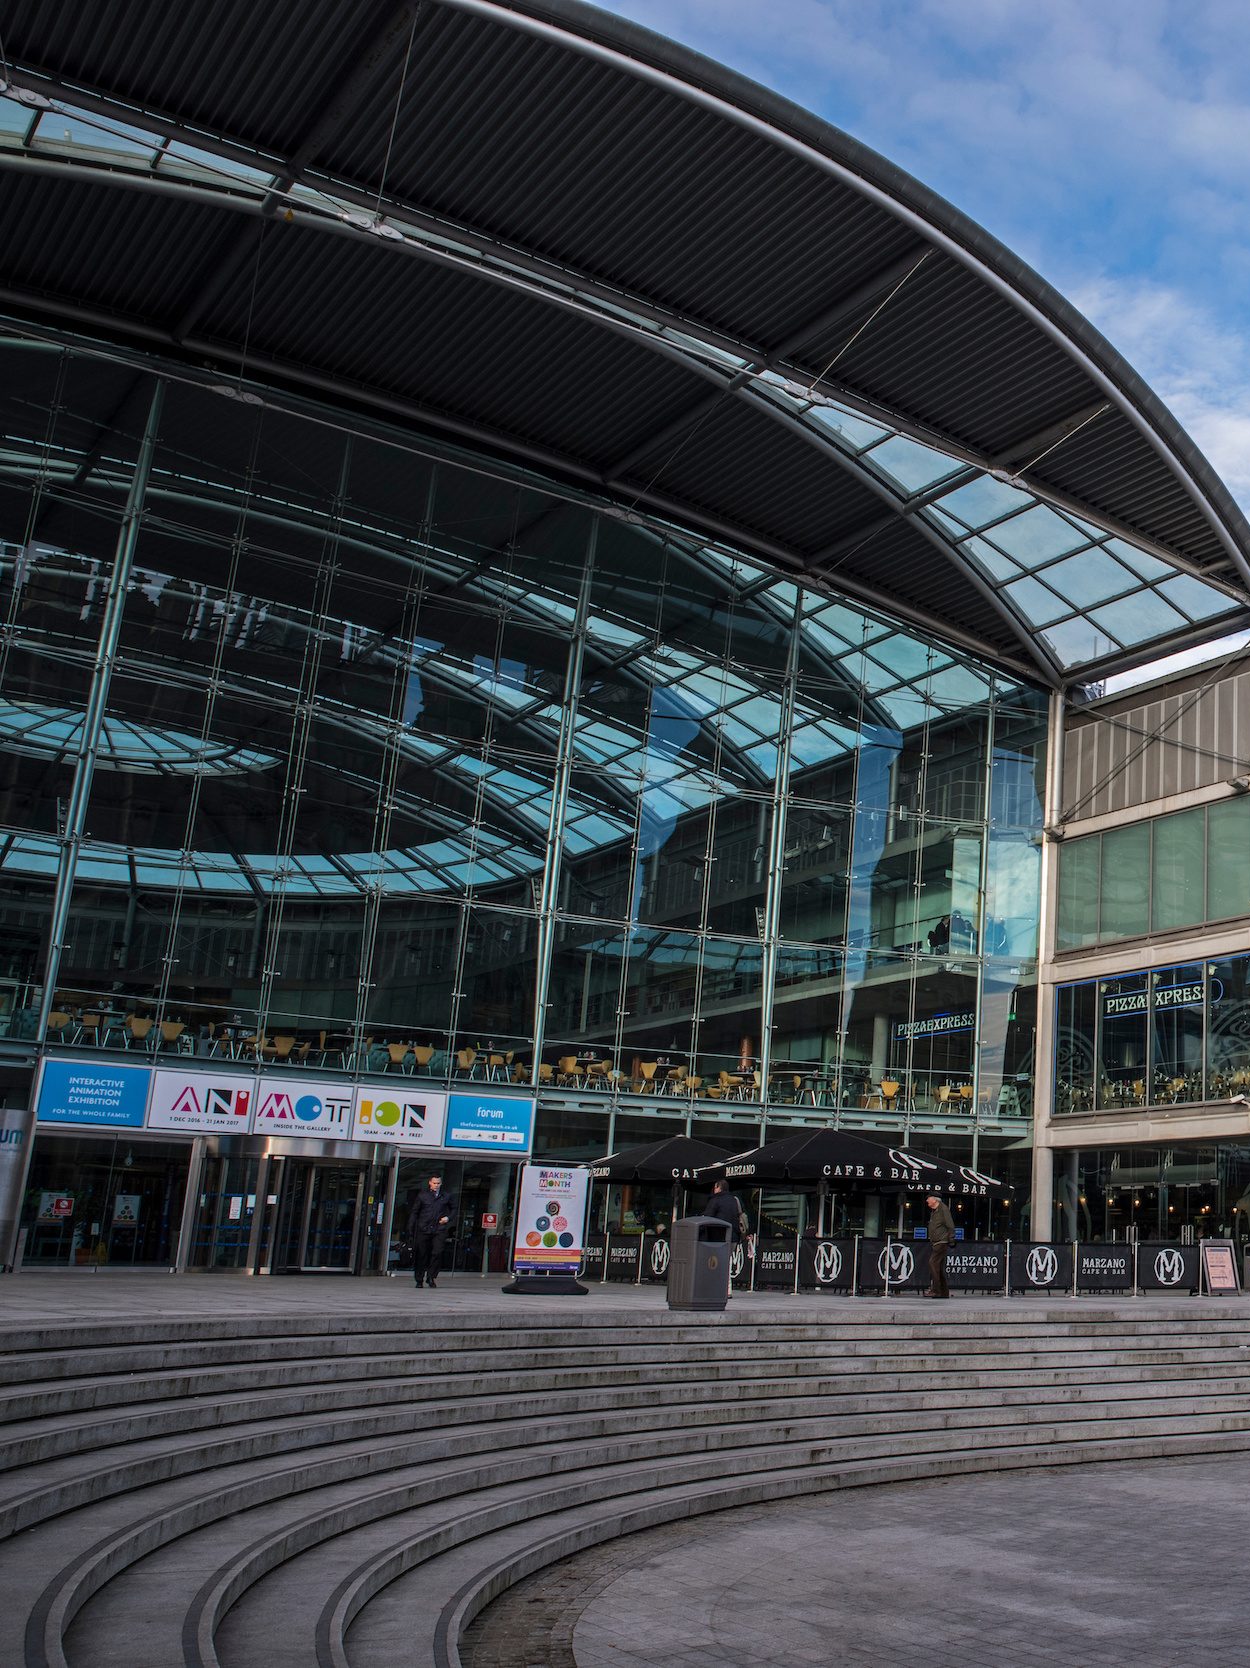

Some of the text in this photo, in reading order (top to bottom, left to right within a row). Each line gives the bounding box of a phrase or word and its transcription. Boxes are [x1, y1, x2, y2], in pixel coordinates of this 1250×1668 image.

[69, 1077, 125, 1088] INTERACTIVE
[69, 1086, 122, 1097] ANIMATION
[68, 1096, 120, 1107] EXHIBITION
[82, 1110, 106, 1118] WHOLE
[107, 1111, 131, 1119] FAMILY
[477, 1106, 504, 1119] forum
[539, 1170, 573, 1180] MAKERS
[671, 1168, 699, 1179] CAF
[725, 1164, 756, 1177] MARZANO
[822, 1164, 921, 1181] CAFE & BAR
[539, 1179, 571, 1188] MONTH
[948, 1182, 956, 1192] &
[962, 1183, 987, 1195] BAR
[761, 1251, 794, 1263] MARZANO
[945, 1255, 999, 1267] MARZANO
[1082, 1257, 1126, 1269] MARZANO
[945, 1266, 967, 1274] CAFE
